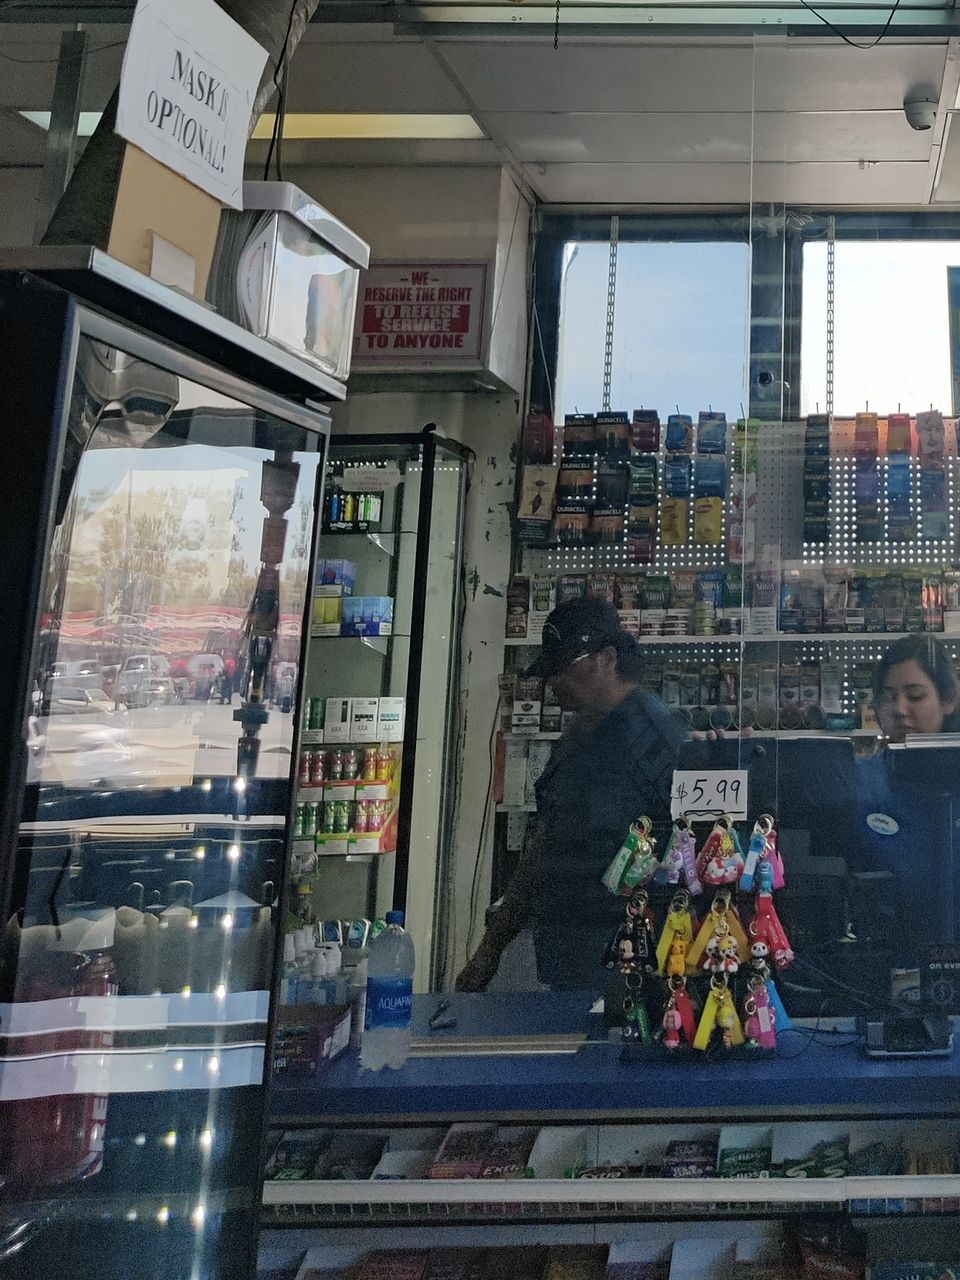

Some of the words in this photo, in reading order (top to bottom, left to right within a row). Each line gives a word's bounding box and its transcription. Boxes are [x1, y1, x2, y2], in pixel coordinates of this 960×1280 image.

[170, 49, 220, 111] MASK
[147, 90, 227, 173] OPTIONAL!
[411, 272, 430, 286] WE
[364, 287, 412, 302] RESERVE
[415, 287, 436, 302] THE
[438, 287, 472, 302] RIGHT
[374, 305, 396, 319] TO
[400, 304, 461, 319] REFUSE
[381, 318, 451, 332] SERVICE
[366, 334, 389, 349] TO
[393, 334, 464, 349] ANYONE
[597, 416, 626, 424] DURACELL
[562, 462, 590, 470] DURACELL
[557, 506, 586, 514] DURACELL
[593, 508, 622, 516] DURACELL
[681, 843, 696, 878] HELLO
